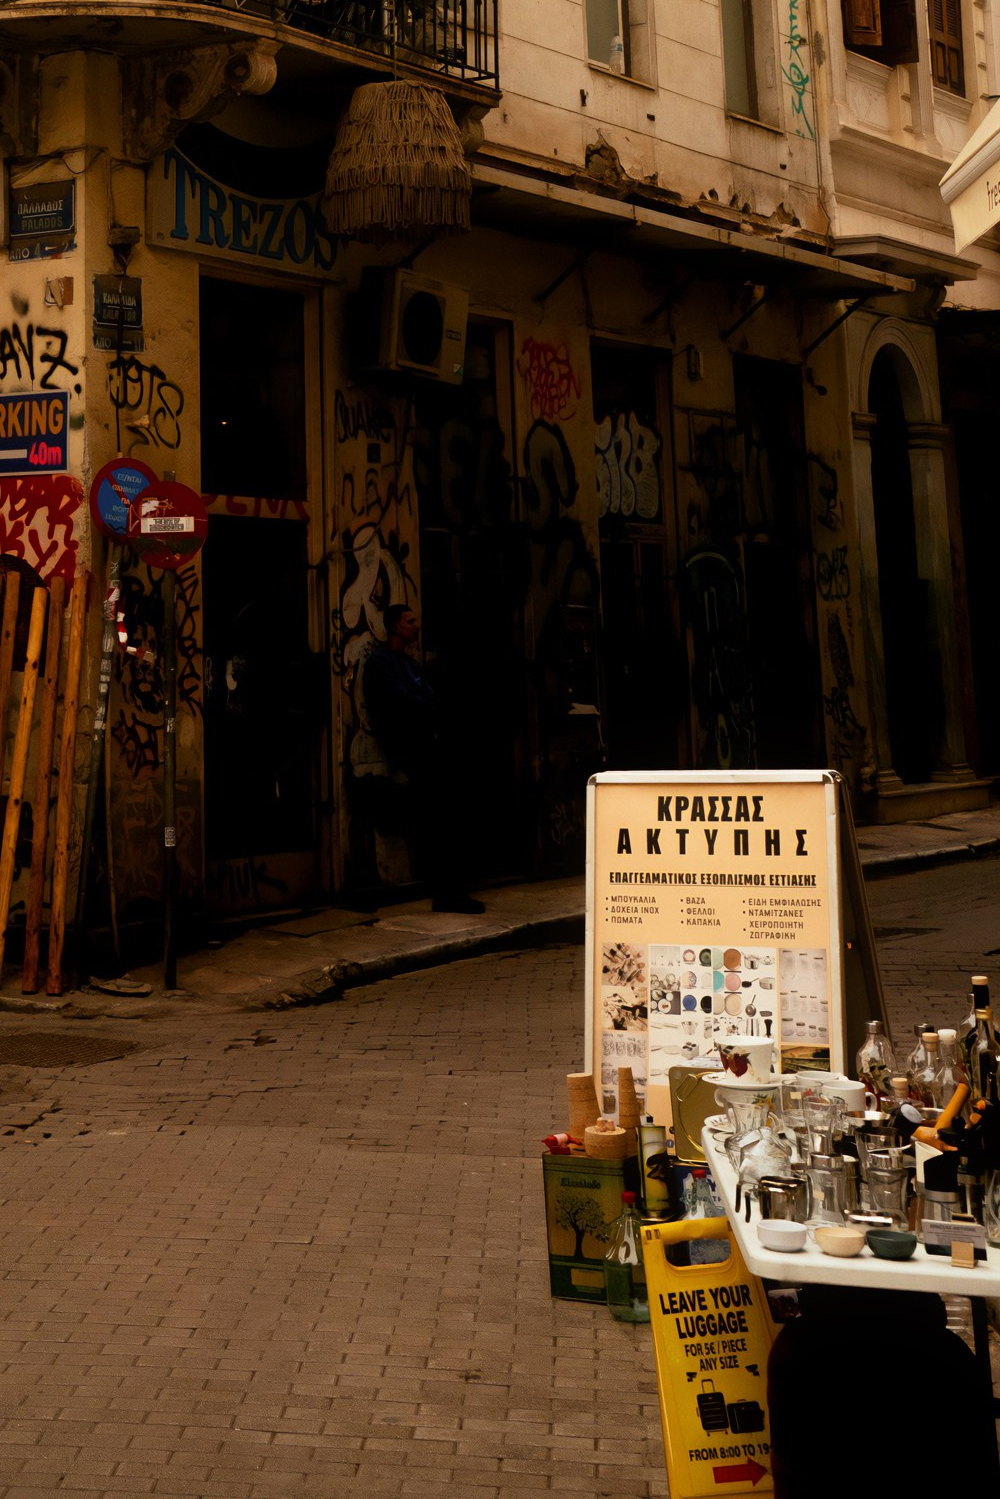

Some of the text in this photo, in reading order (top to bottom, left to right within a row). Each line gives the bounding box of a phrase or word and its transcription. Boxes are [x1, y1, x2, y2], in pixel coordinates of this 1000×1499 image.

[17, 200, 63, 215] ΠΑΛΛΑΔΟΣ
[27, 441, 63, 465] 40m
[657, 795, 764, 822] ΚΡΑΣΣΑΣ
[609, 871, 816, 887] ΕΠΑΓΓΕΛΜΑΤΙΚΟΣ ΕΞΟΠΛΙΣΜΟΣ ΕΣΤΙΑΣΗΣ
[611, 895, 656, 904] ΜΠΟΥΚΑΛΙΑ
[686, 897, 705, 905] ΒΑΖΑ
[748, 898, 822, 907] ΕΙΔΗ ΕΜΦΙΑΛΩΣΗΣ
[611, 905, 639, 914] ΔΟΧΕΙΑ
[686, 907, 715, 916] ΦΕΛΛΟΙ
[748, 909, 804, 918] ΝΤΑΜΙΤΖΑΝΕΣ
[611, 916, 643, 925] ΠΩΜΑΤΑ
[686, 918, 721, 927] ΚΑΠΑΚΙΑ
[749, 920, 804, 929] ΧΕΙΡΟΠΟΙΗΤΗ
[749, 931, 796, 940] ΖΩΓΡΑΦΙΚΗ
[659, 1284, 753, 1315] LEAVE YOUR
[675, 1311, 749, 1339] LUGGAGE
[684, 1343, 702, 1357] FOR
[704, 1342, 716, 1355] 5€
[721, 1338, 747, 1353] PIECE
[699, 1355, 739, 1372] ANY SIZE
[689, 1447, 718, 1462] FROM
[720, 1445, 741, 1459] 8:00
[741, 1443, 755, 1457] TO
